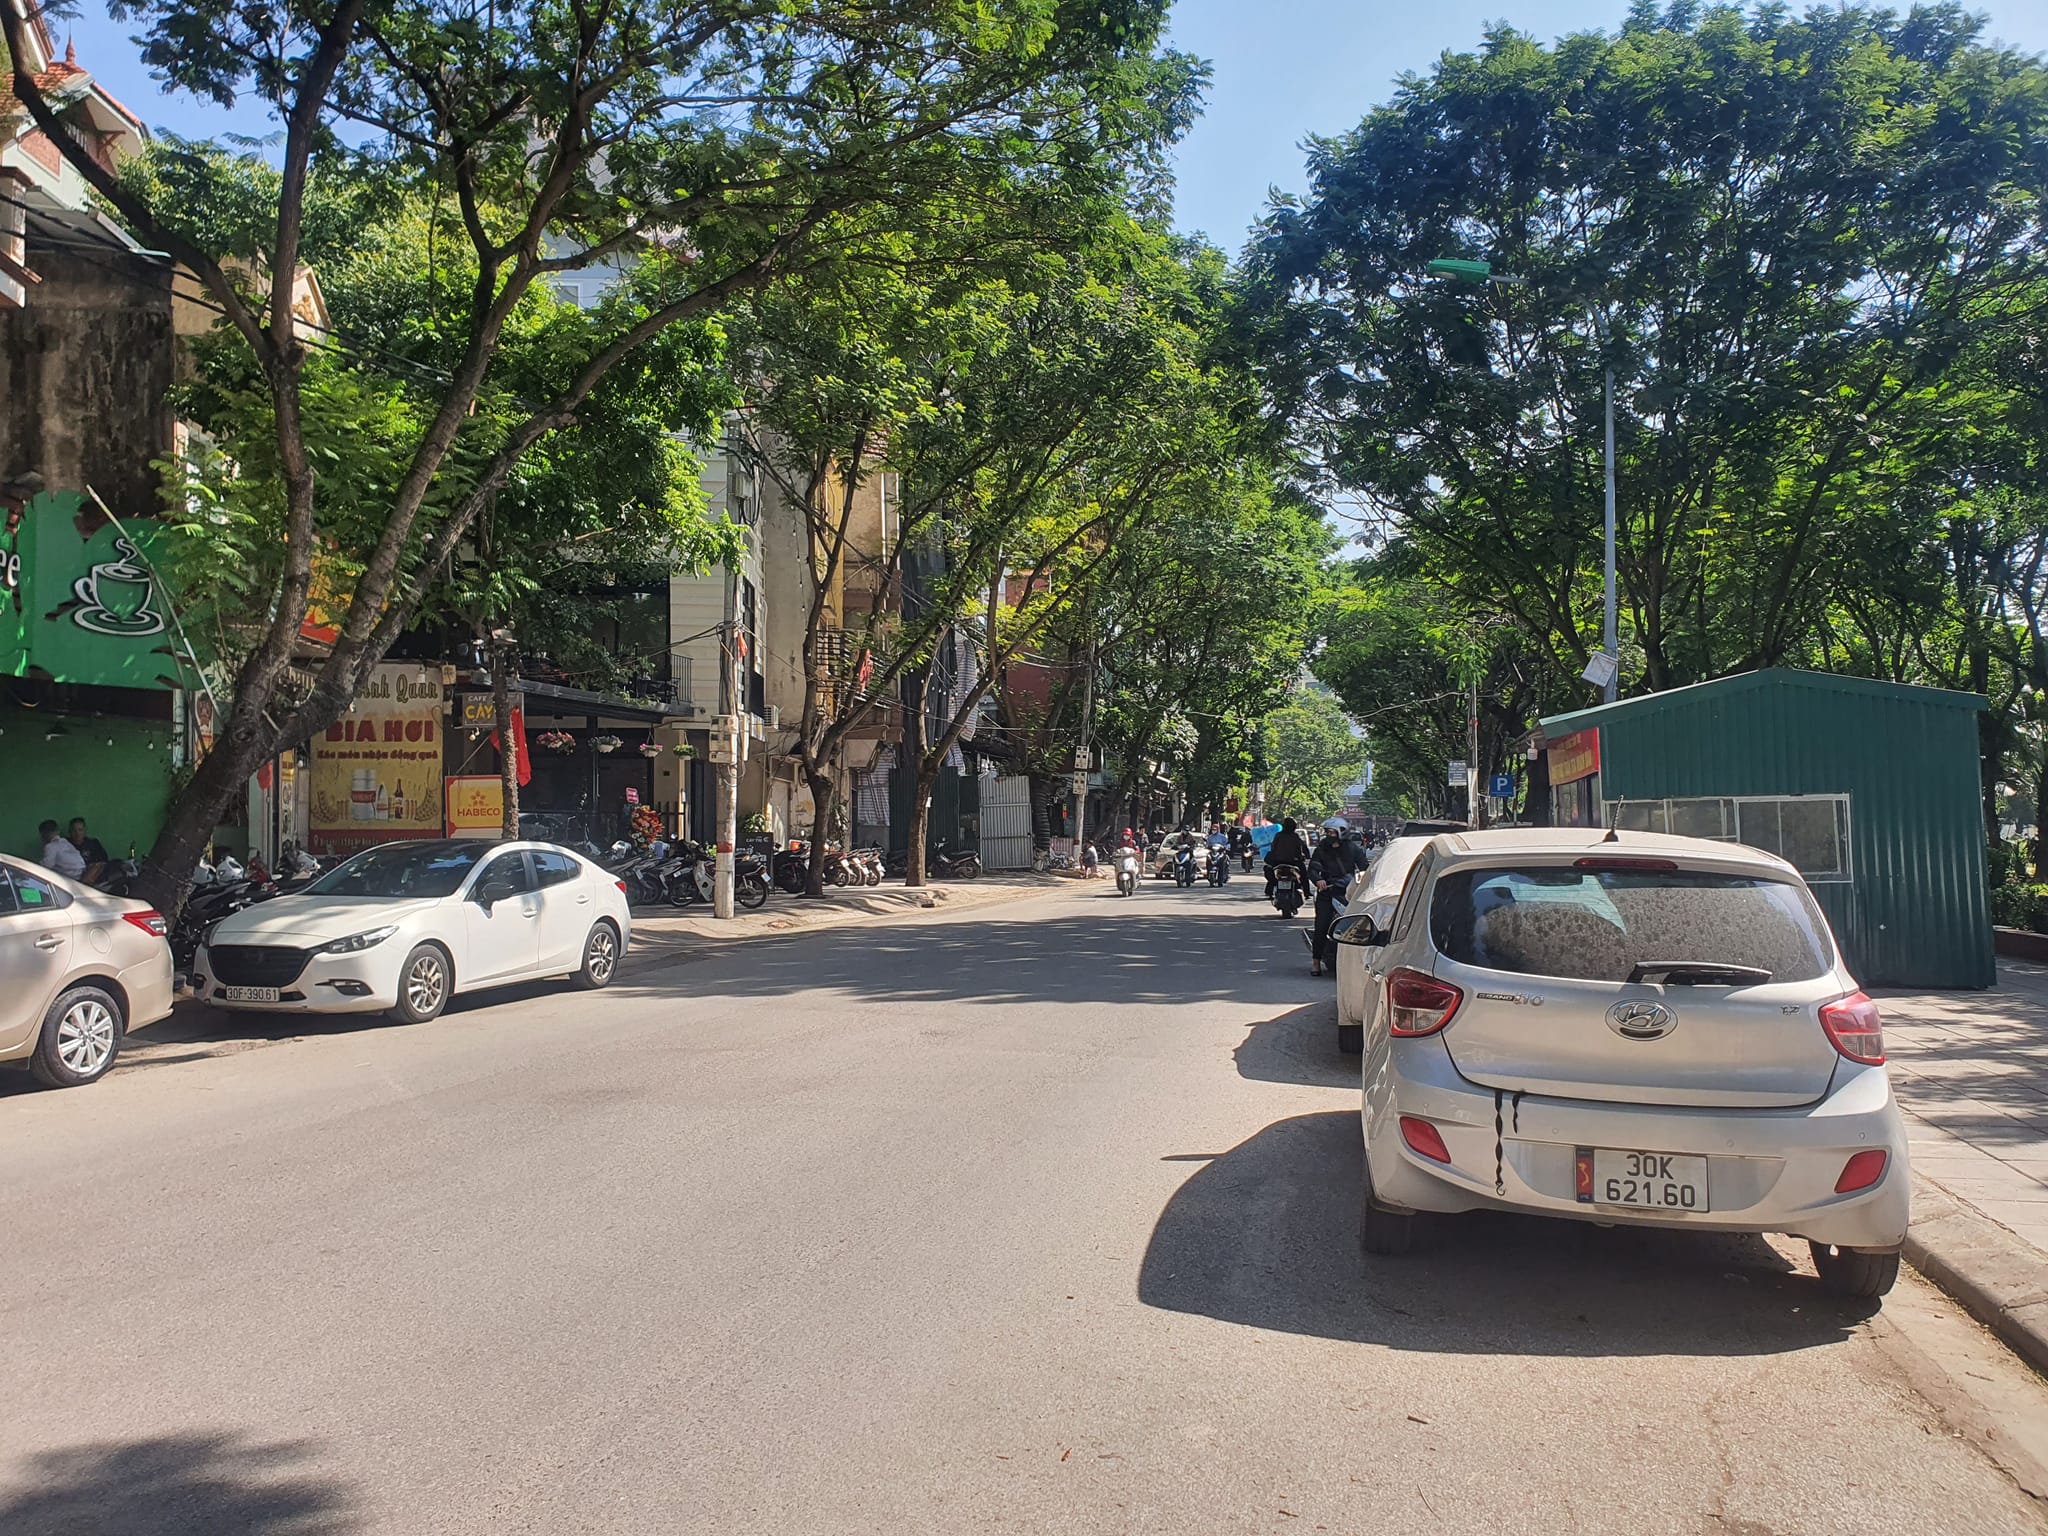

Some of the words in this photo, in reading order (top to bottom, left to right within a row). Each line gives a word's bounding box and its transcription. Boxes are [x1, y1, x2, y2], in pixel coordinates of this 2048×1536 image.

[326, 719, 377, 742] BIA
[1497, 777, 1508, 791] P
[457, 807, 501, 817] HABECO
[1626, 1154, 1674, 1180] 30K
[1606, 1178, 1696, 1208] 621.60
